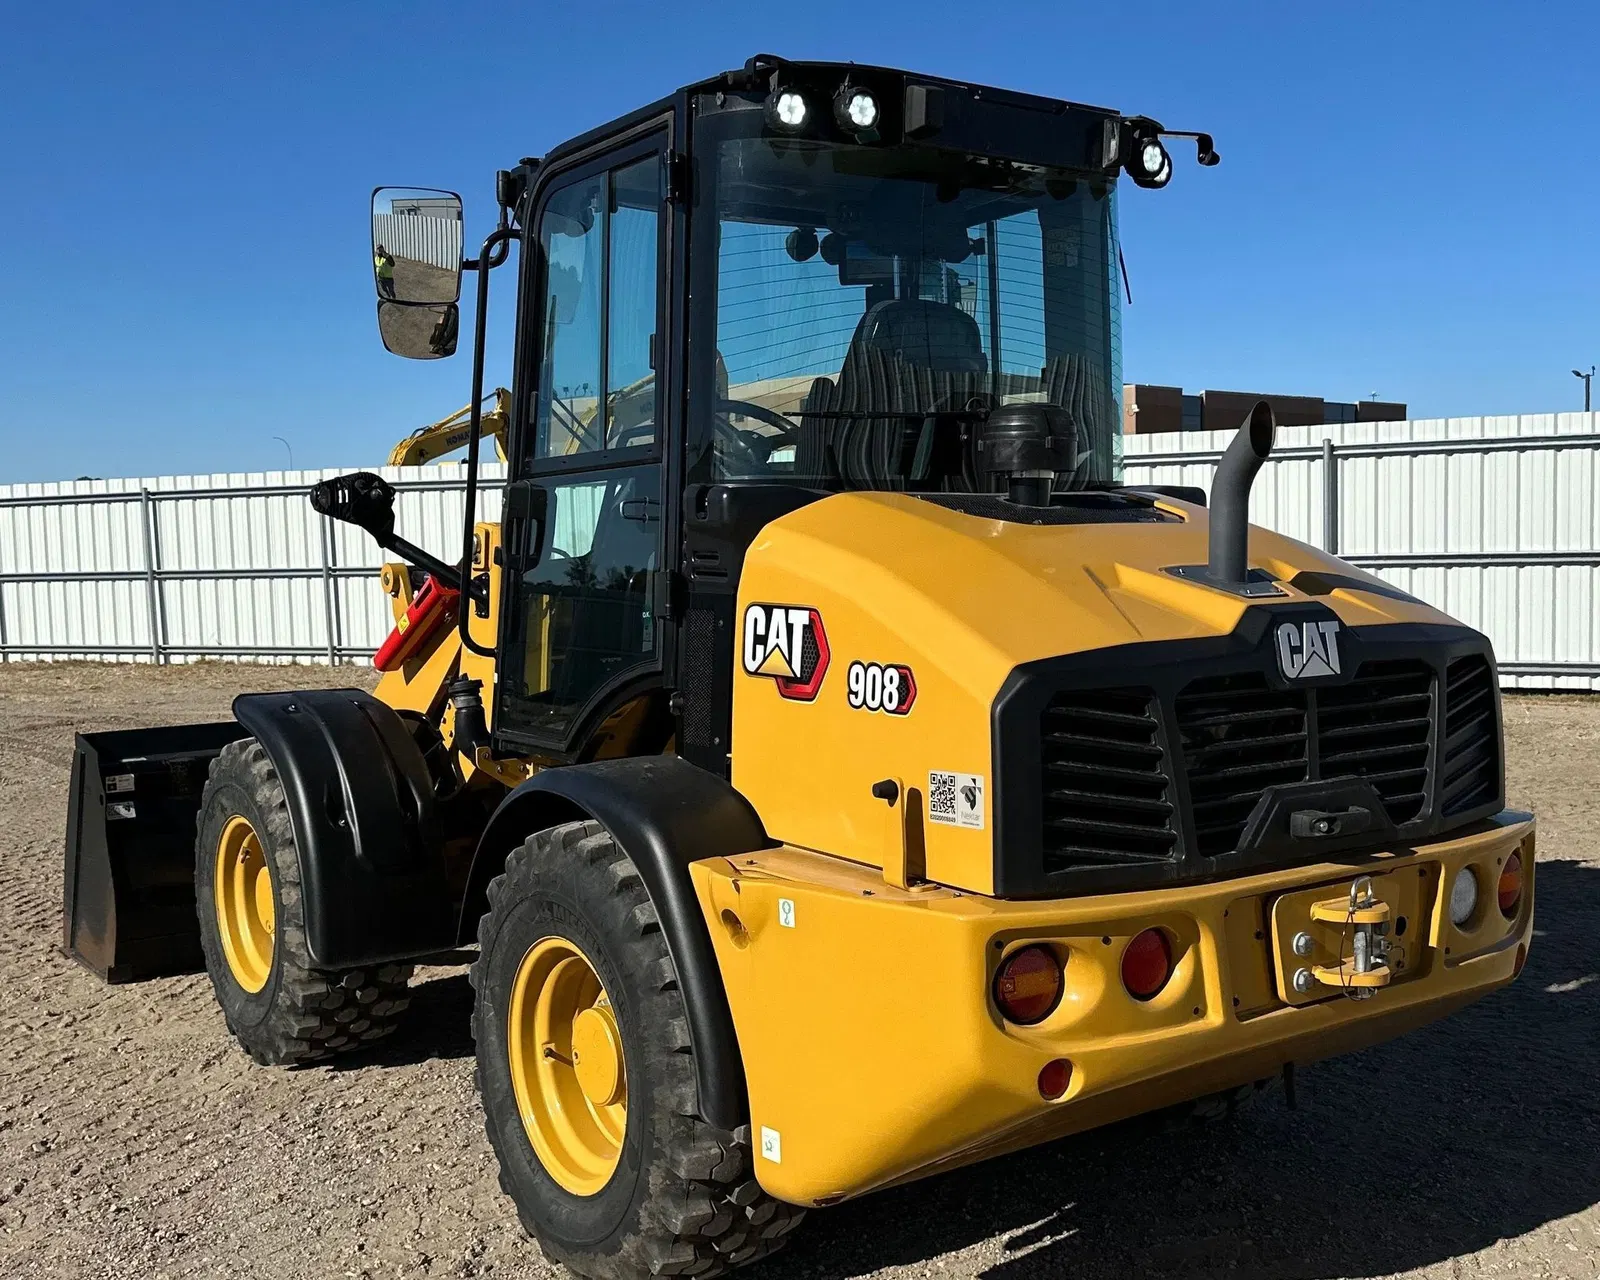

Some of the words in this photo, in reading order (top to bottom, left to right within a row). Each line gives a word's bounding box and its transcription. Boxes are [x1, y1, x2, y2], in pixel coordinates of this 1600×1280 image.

[744, 605, 810, 678] CAT
[1277, 620, 1341, 678] CAT
[849, 663, 900, 711] 908
